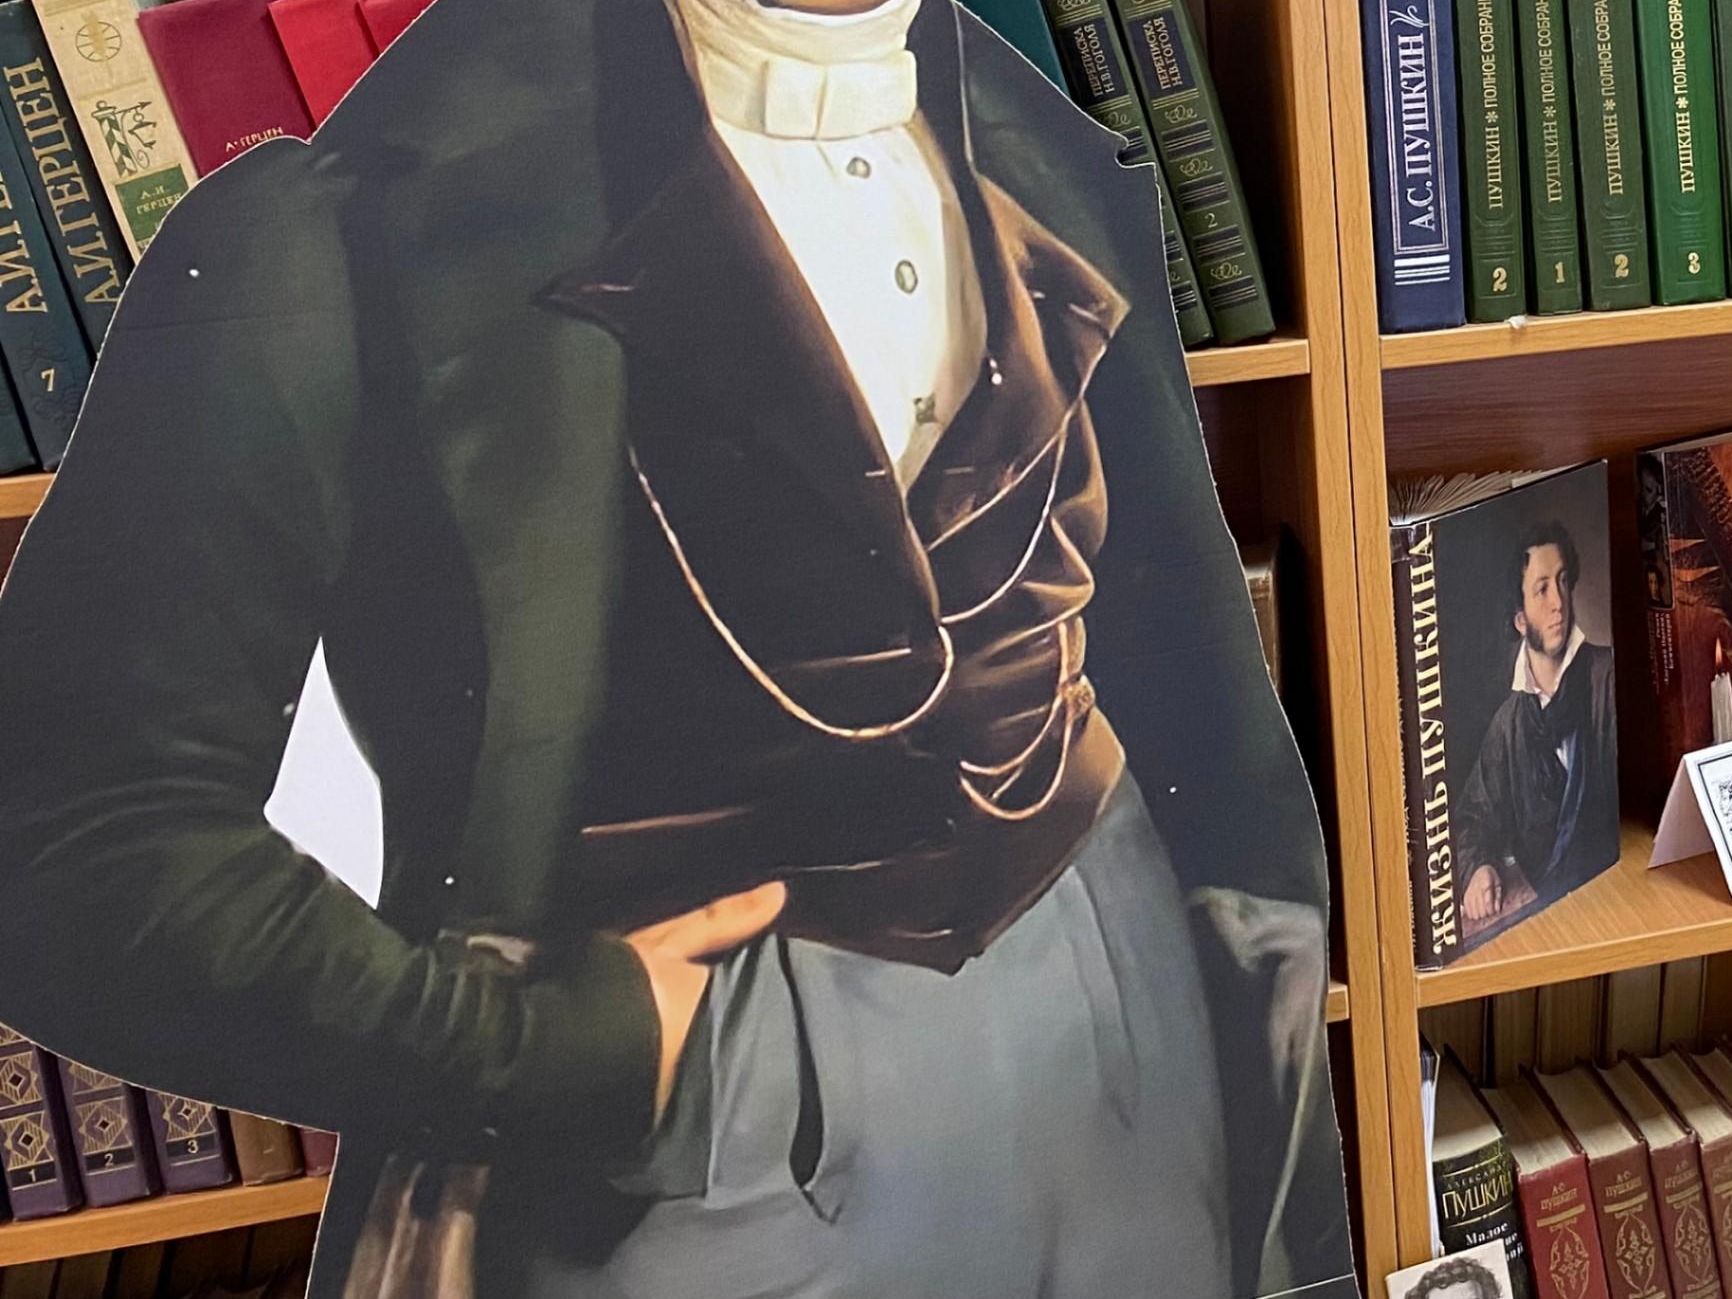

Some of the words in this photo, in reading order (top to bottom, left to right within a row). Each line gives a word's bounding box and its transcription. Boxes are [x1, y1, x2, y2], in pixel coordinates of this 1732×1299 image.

[1143, 21, 1171, 90] ПЕРЕПИСКА
[1671, 41, 1688, 94] ПОЛНОЕ
[1398, 33, 1431, 178] ПУШКИН
[1676, 111, 1696, 193] ПУШКИН
[1206, 212, 1218, 228] 2
[1407, 181, 1435, 231] А.С.
[1492, 268, 1508, 292] 2
[1554, 262, 1565, 284] 1
[1688, 252, 1700, 274] 3
[41, 368, 54, 392] 7
[1408, 521, 1445, 780] ПУШКИНА
[1424, 790, 1458, 955] ЖИЗНЬ
[187, 1140, 199, 1153] 3
[29, 1170, 37, 1182] 1
[1442, 1171, 1514, 1219] ПУШКИН
[1465, 1220, 1508, 1246] Малое
